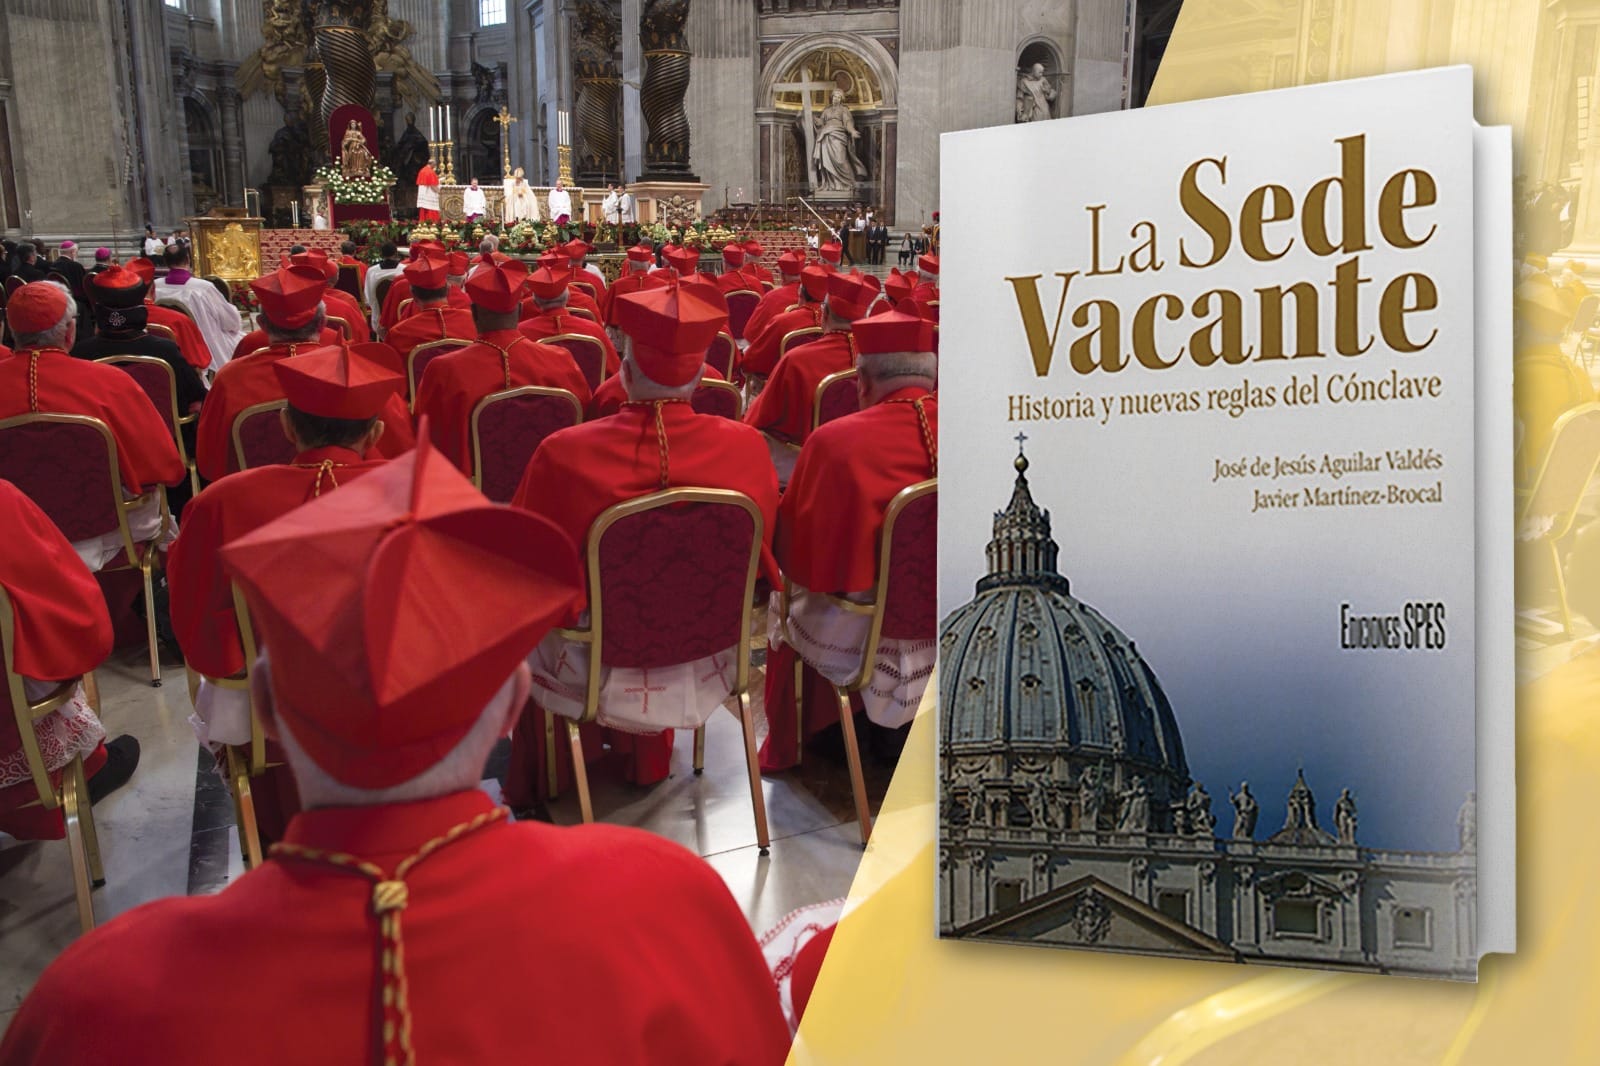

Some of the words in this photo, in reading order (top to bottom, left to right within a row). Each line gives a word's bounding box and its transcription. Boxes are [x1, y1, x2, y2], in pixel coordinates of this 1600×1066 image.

[1085, 204, 1164, 276] La
[1179, 133, 1438, 268] Sede
[1004, 255, 1439, 377] Vacante
[1007, 391, 1096, 421] Historia
[1100, 396, 1114, 425] y
[1119, 390, 1201, 415] nuevas
[1207, 379, 1277, 418] reglas
[1283, 373, 1319, 406] del
[1327, 369, 1442, 404] Cónclave
[1212, 457, 1247, 482] José
[1250, 455, 1271, 477] de
[1271, 453, 1316, 480] Jesús
[1319, 450, 1381, 480] Aguilar
[1385, 448, 1443, 470] Valdés
[1251, 488, 1299, 513] Javier
[1303, 481, 1442, 507] Martínez-Brocal
[1404, 602, 1445, 649] SPES
